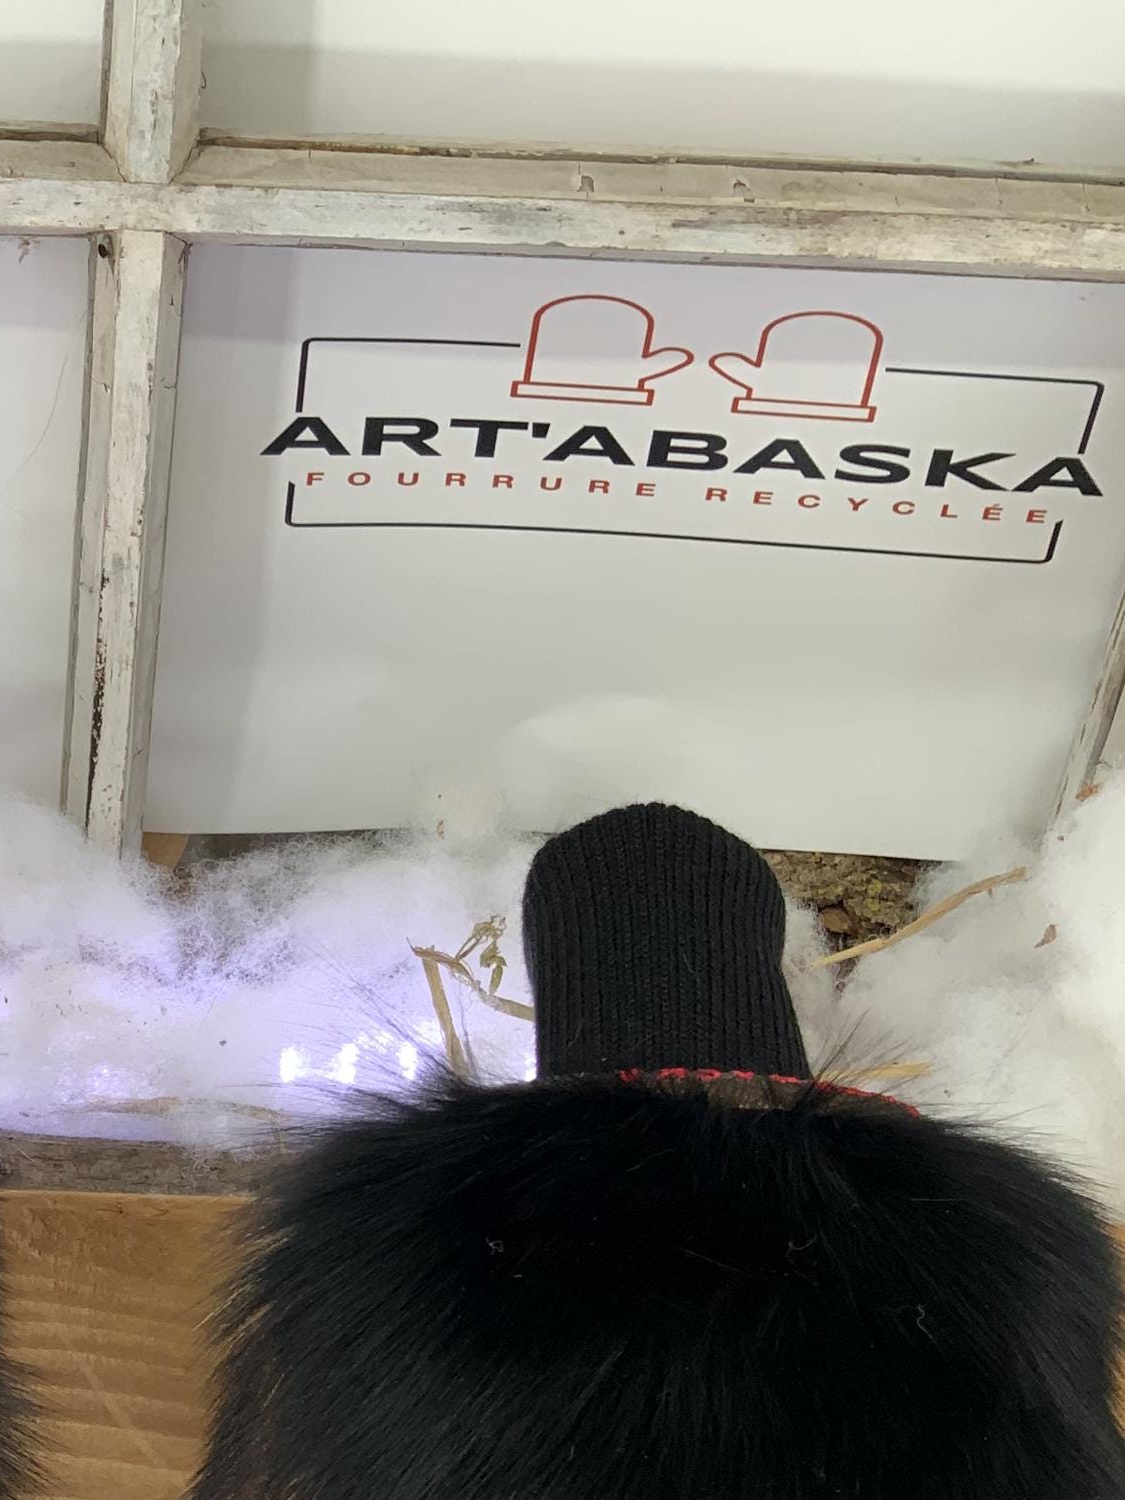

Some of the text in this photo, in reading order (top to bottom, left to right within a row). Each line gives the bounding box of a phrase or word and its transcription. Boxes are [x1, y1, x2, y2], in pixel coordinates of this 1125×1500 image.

[260, 416, 1105, 496] ART'ABASKA
[305, 471, 1049, 524] FOURRURE RECYCLÉE
